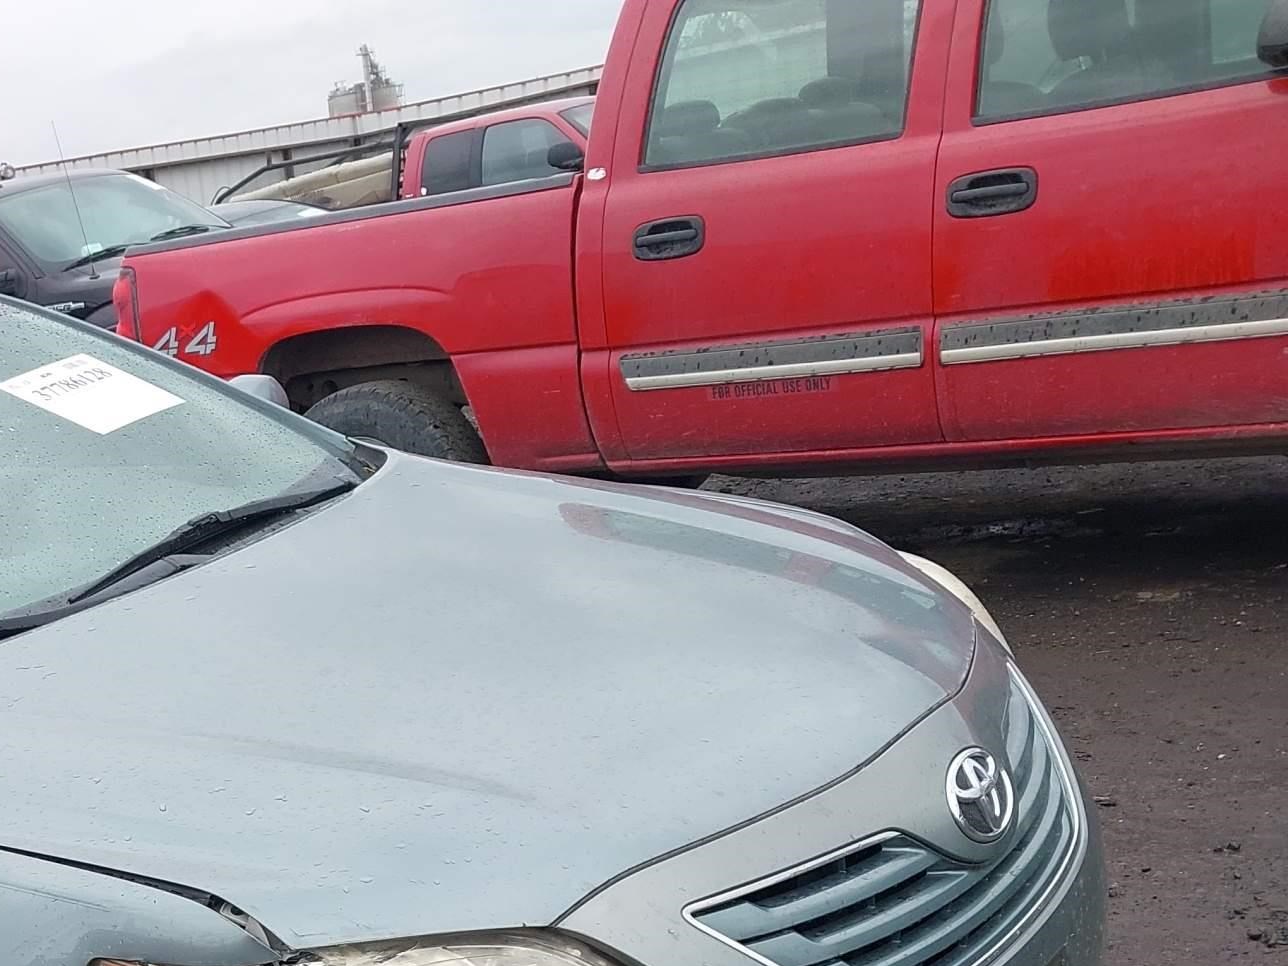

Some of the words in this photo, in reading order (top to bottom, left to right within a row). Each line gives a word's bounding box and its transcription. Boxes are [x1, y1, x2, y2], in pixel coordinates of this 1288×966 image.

[712, 385, 732, 400] FOR
[733, 381, 779, 398] OFFICIAL
[782, 379, 803, 394] USE
[806, 377, 831, 392] ONLY
